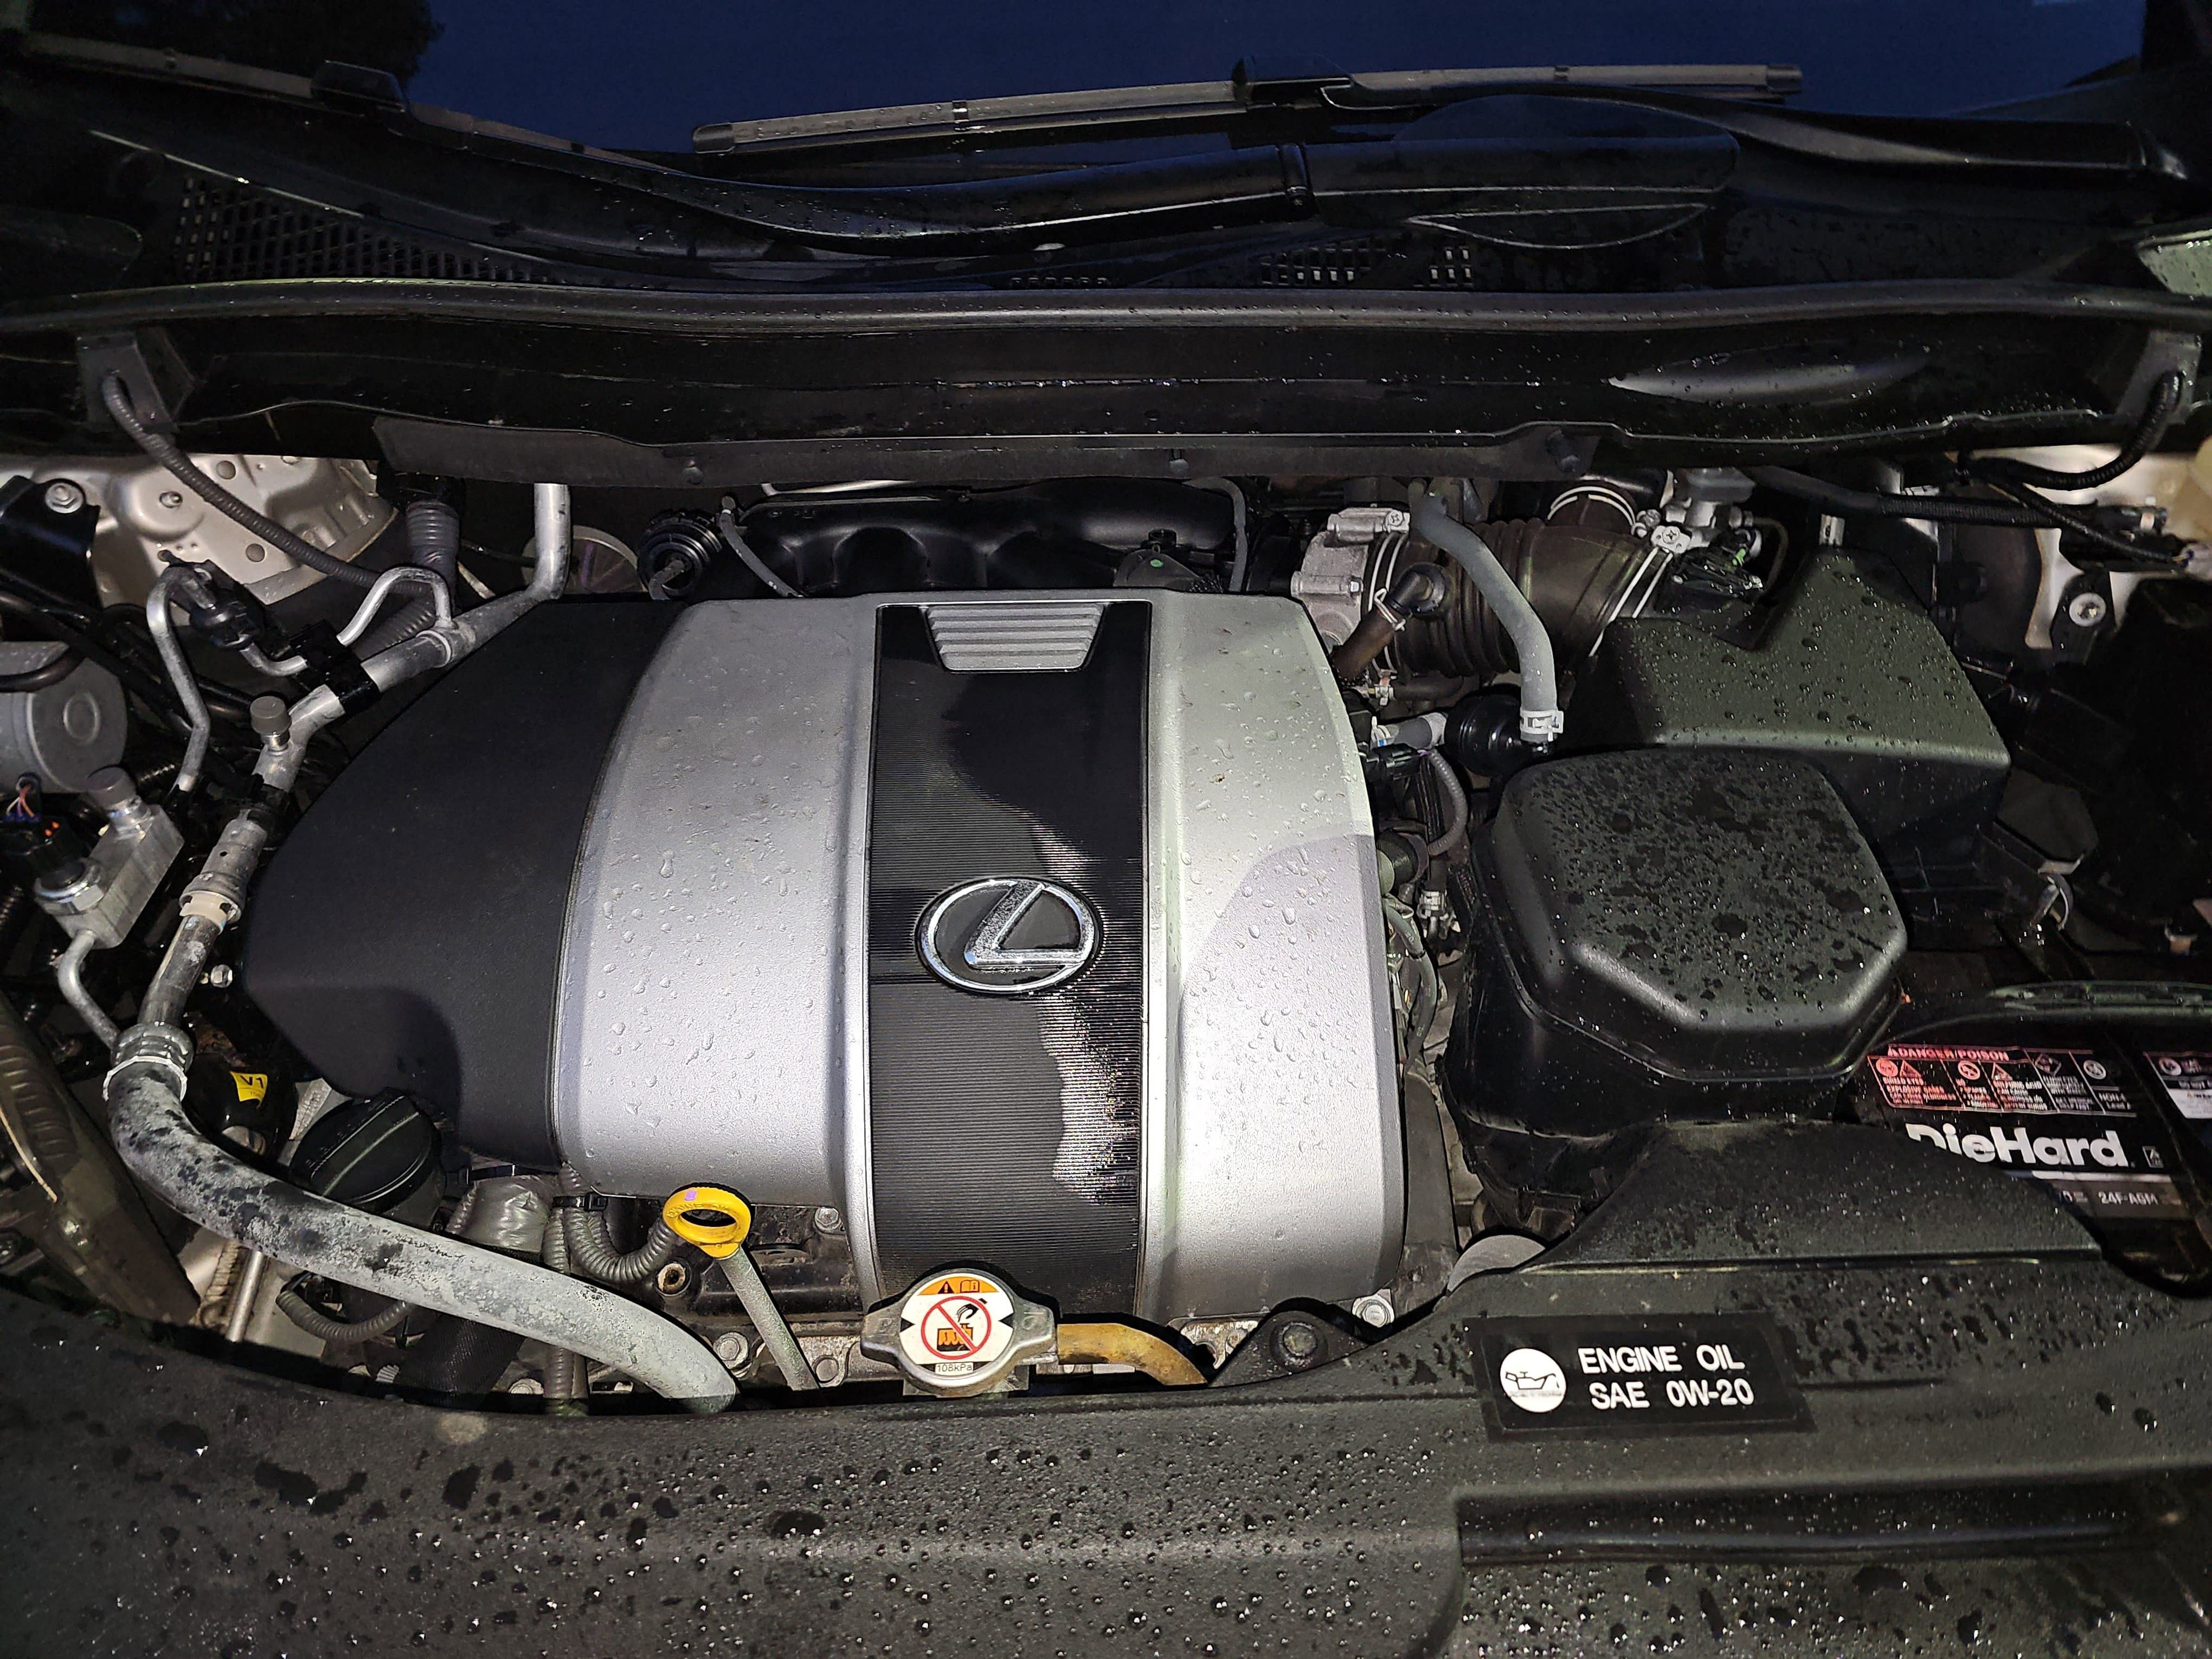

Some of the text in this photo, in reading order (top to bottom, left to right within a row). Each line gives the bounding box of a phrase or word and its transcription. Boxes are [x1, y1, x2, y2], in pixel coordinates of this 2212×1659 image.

[240, 1075, 263, 1089] V1
[937, 1363, 972, 1372] 108kPa
[1578, 1345, 1745, 1374] ENGINE OIL
[1589, 1380, 1754, 1410] SAE 0W-20
